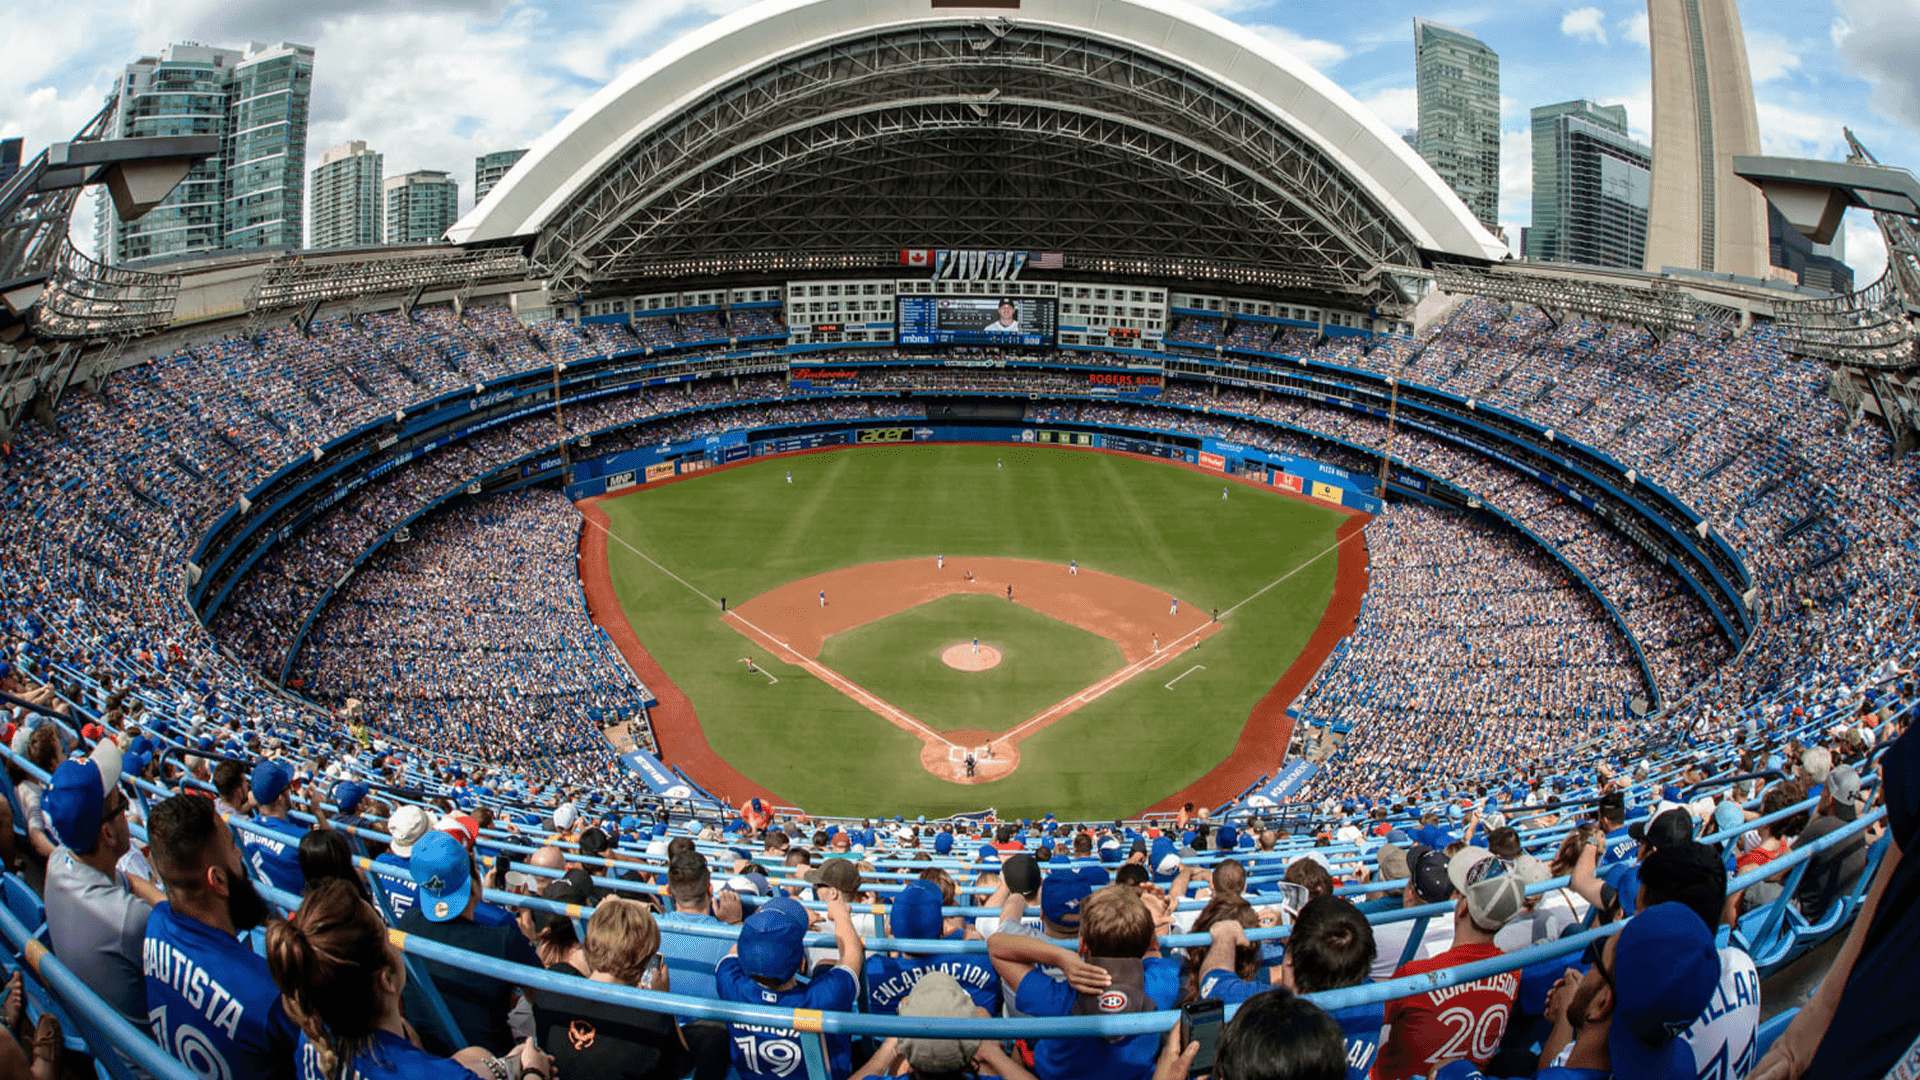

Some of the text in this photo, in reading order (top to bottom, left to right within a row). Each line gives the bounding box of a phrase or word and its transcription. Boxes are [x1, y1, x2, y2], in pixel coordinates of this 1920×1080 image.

[903, 334, 929, 344] mbna
[792, 368, 858, 379] Budweiser
[1089, 374, 1133, 385] ROGERS
[861, 428, 909, 442] acer
[541, 458, 562, 471] mbna
[610, 472, 632, 487] MNP
[1400, 475, 1422, 489] mbna
[143, 937, 244, 1041] BAUTISTA
[1684, 969, 1759, 1040] LLAR
[1424, 1003, 1509, 1063] 20
[734, 1035, 802, 1078] 19
[1343, 1038, 1375, 1071] AN
